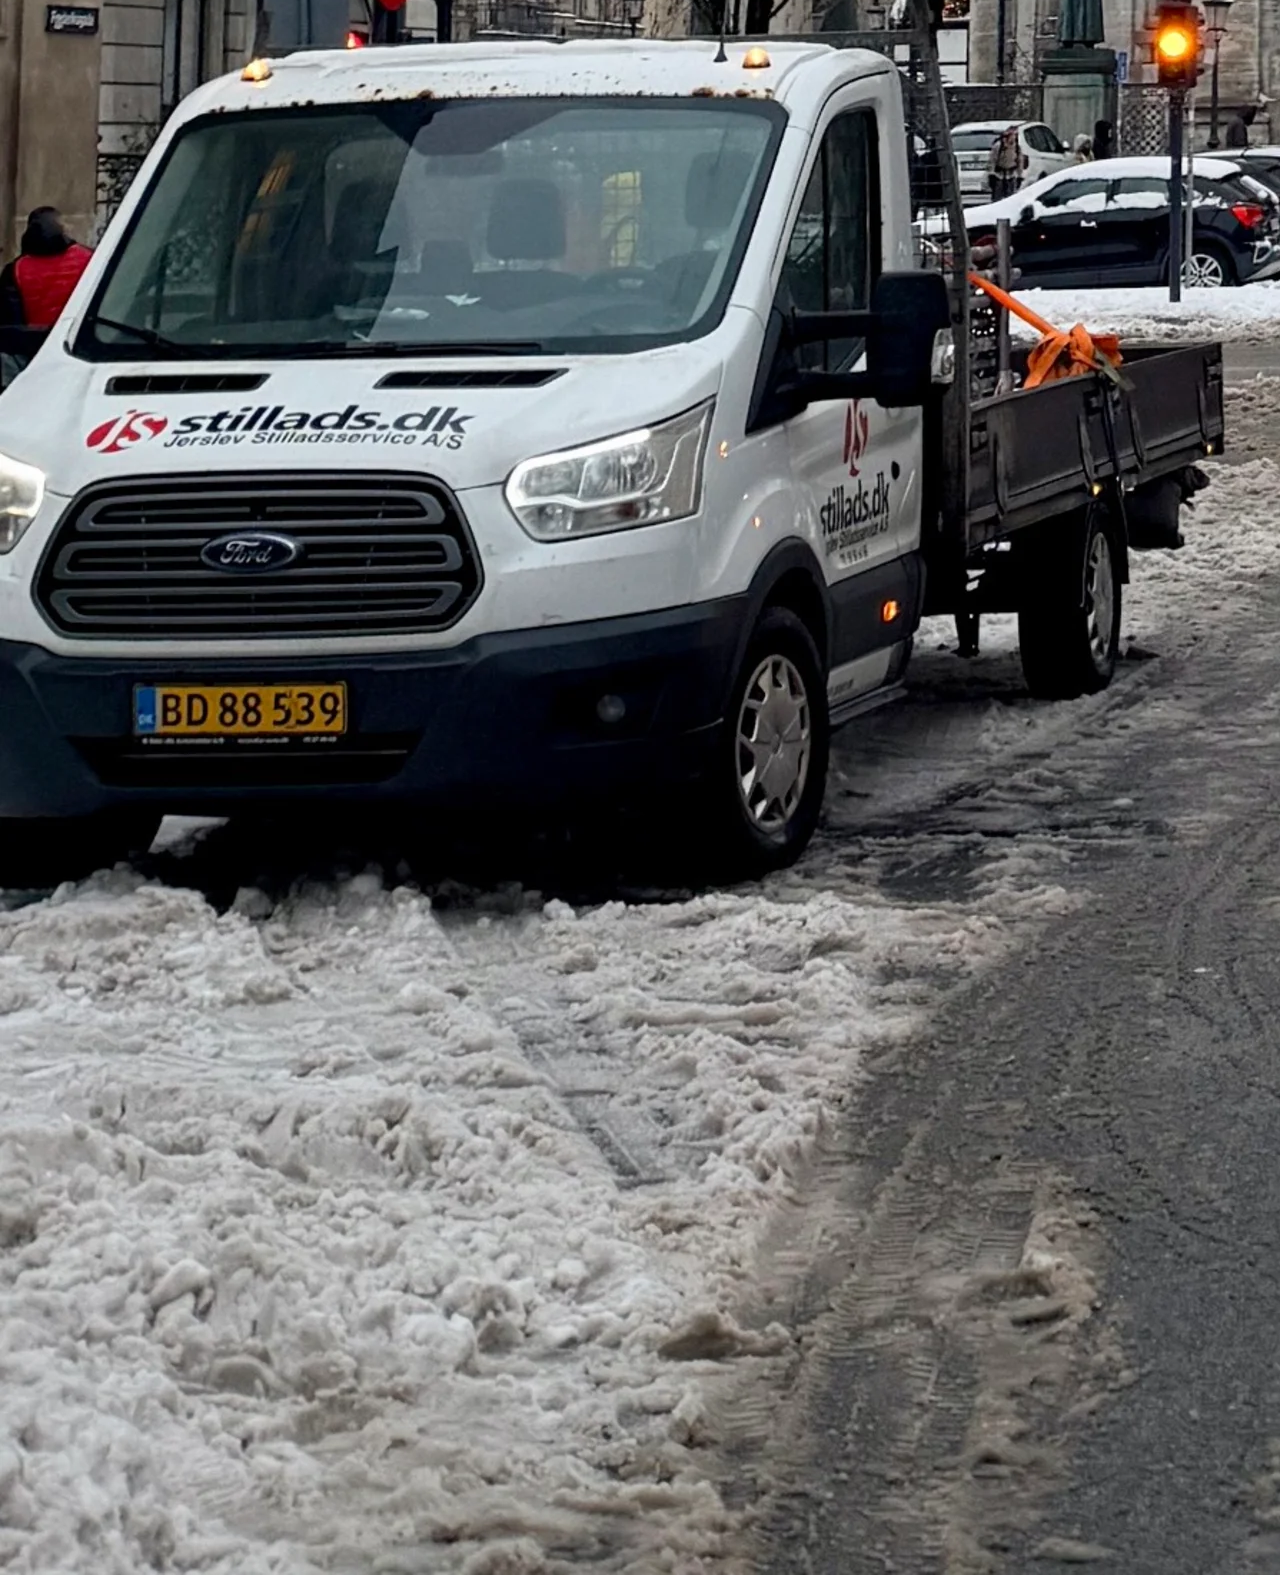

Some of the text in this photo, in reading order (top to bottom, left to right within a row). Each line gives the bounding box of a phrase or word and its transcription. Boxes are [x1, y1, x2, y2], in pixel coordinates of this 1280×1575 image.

[172, 404, 477, 435] stillads.dk
[163, 430, 465, 451] Jerslev Stilladsservice A/S
[820, 471, 890, 537] stillads.dk
[220, 540, 273, 565] Ford
[162, 693, 208, 726] BD
[219, 692, 262, 727] 88
[272, 692, 340, 727] 539
